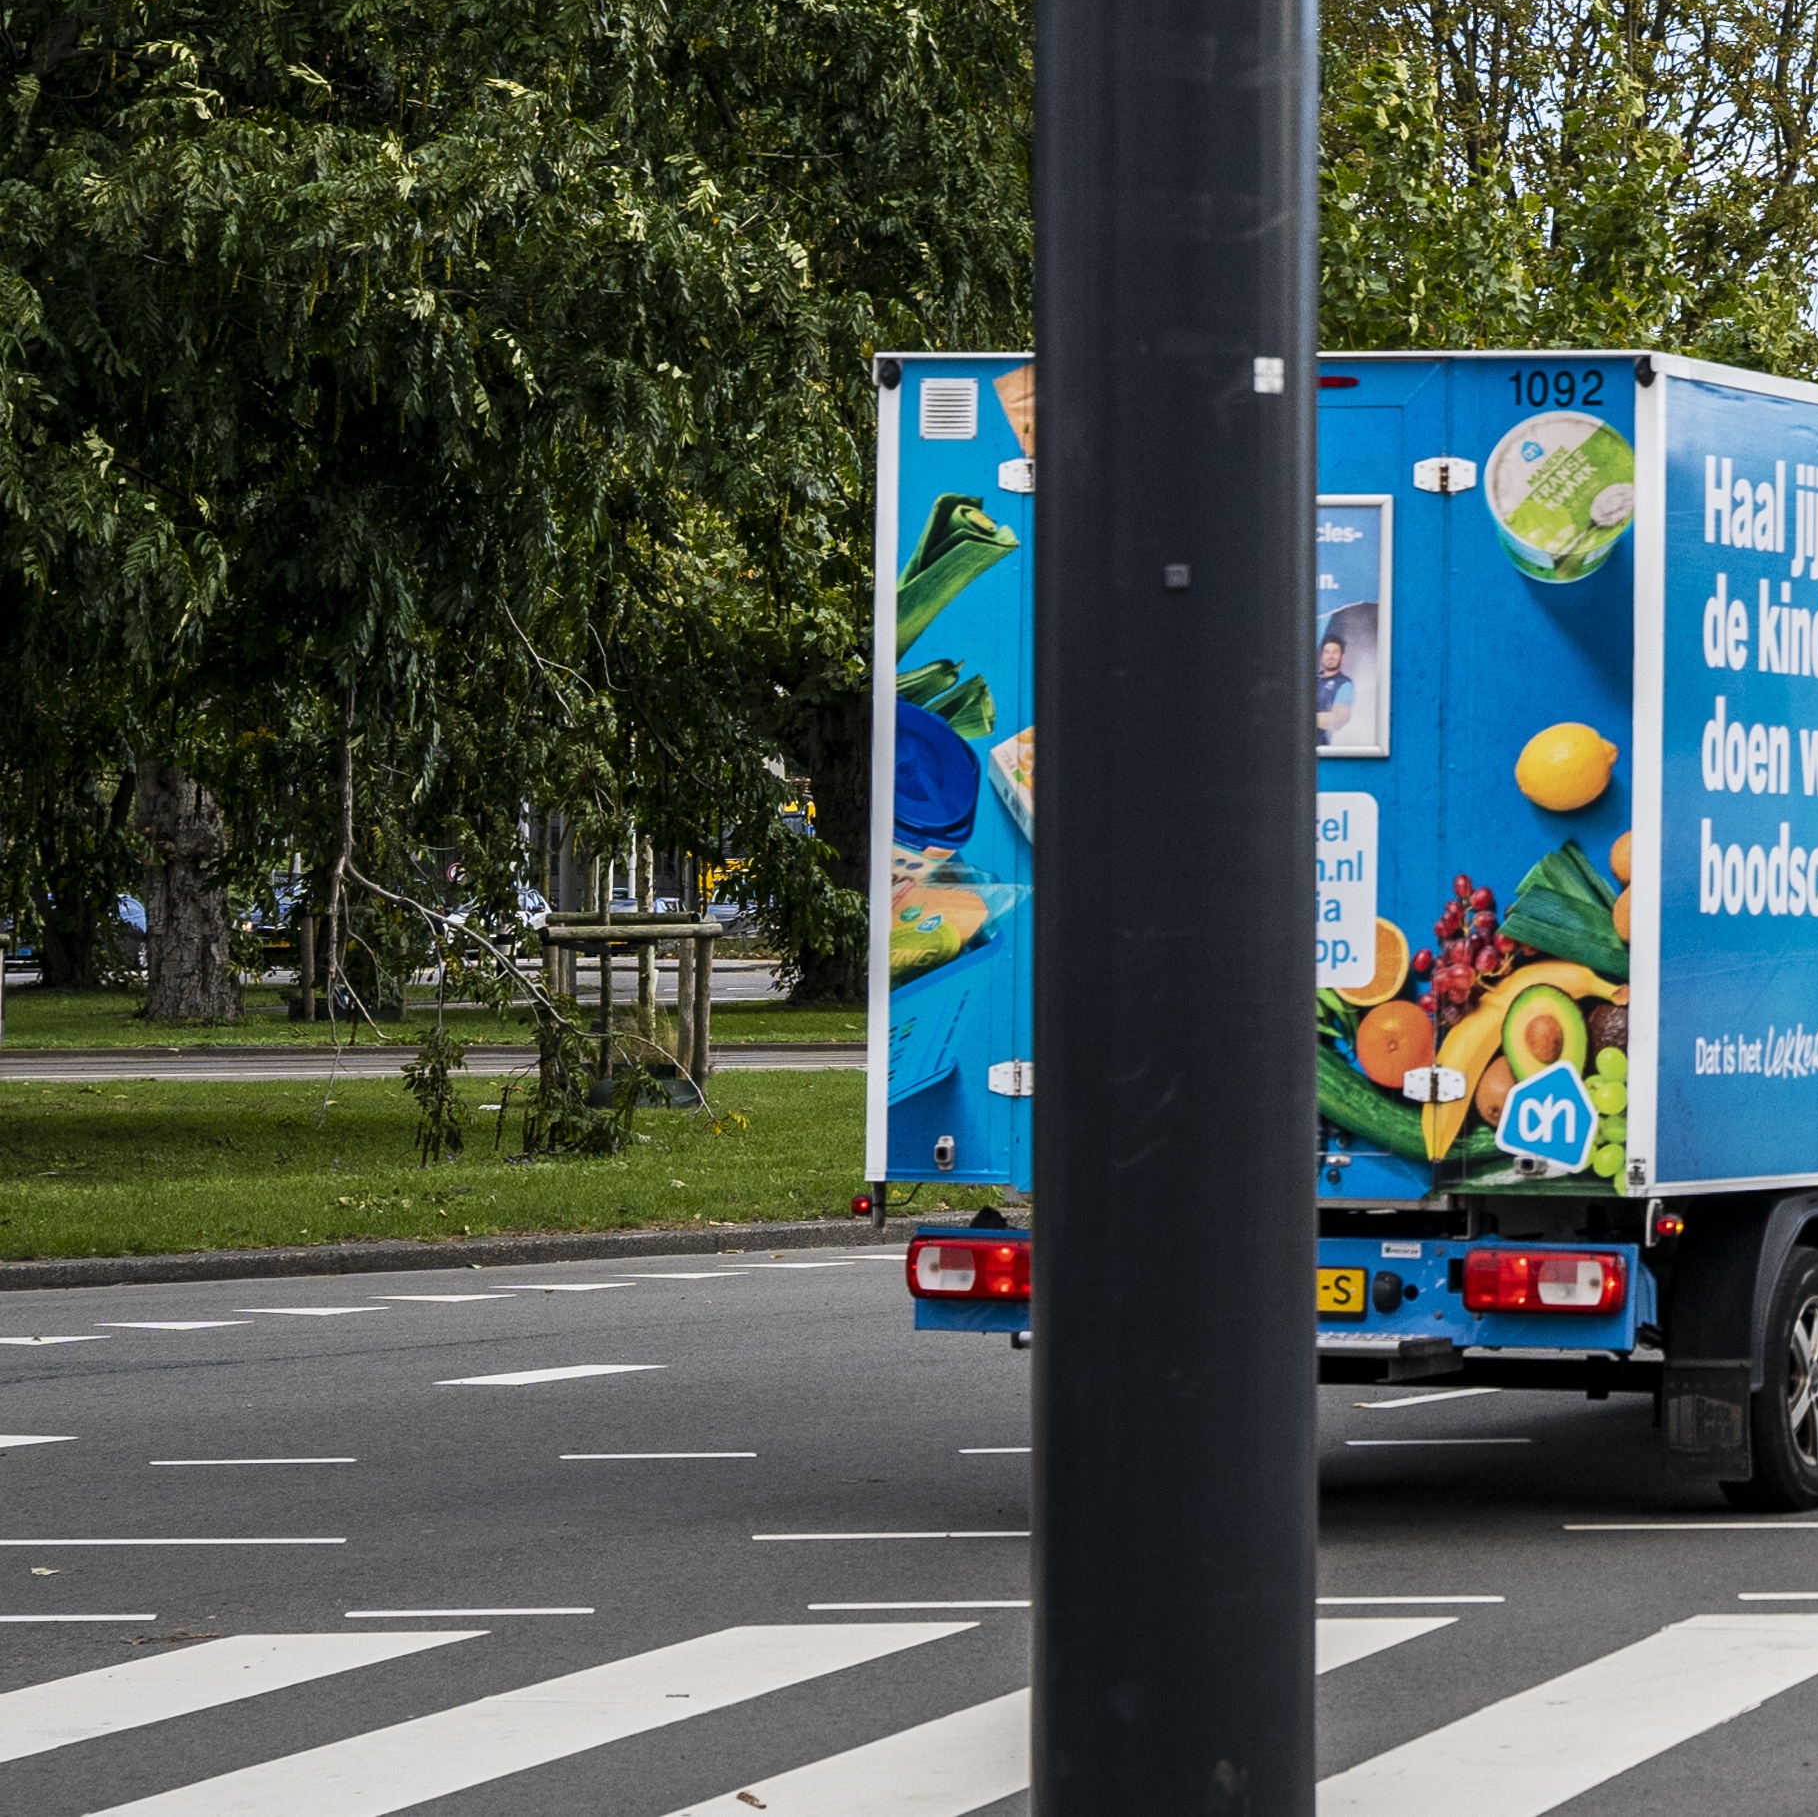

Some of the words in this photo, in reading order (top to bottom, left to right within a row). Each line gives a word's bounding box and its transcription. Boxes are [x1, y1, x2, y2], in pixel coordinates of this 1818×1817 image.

[1508, 369, 1604, 408] 1092
[1531, 450, 1589, 505] FRANSE
[1704, 454, 1786, 553] Haal
[1702, 572, 1748, 671] de
[1702, 695, 1790, 795] doen
[1695, 1037, 1721, 1075] Dat
[1723, 1034, 1735, 1074] is
[1738, 1034, 1762, 1074] het
